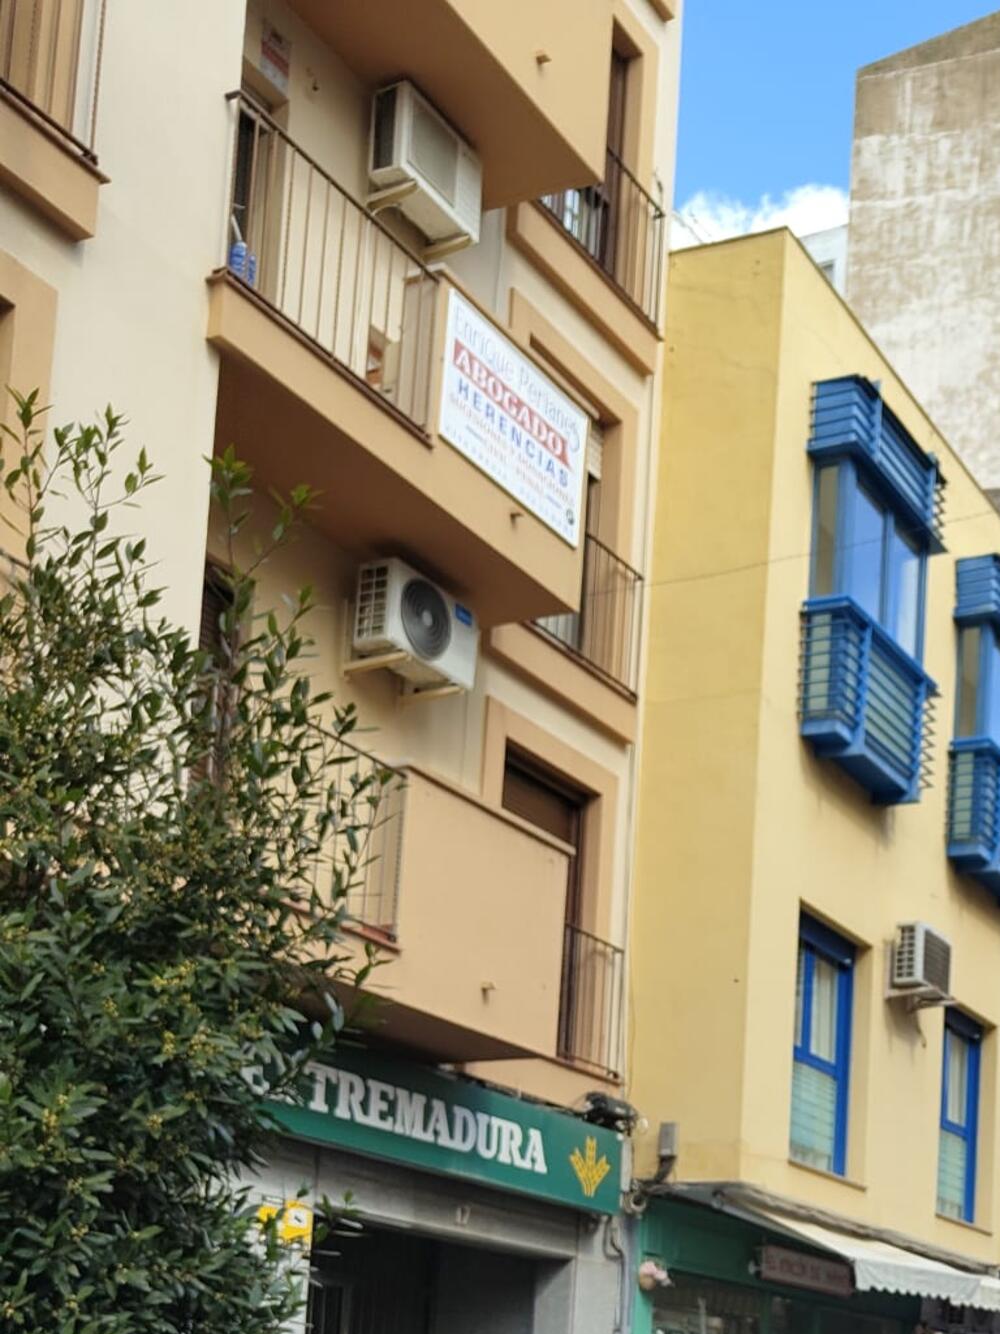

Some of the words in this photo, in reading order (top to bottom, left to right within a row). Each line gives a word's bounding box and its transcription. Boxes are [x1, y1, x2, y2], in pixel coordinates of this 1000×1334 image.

[455, 346, 566, 457] ABOGADO
[457, 377, 569, 489] HERENCIAS
[240, 1060, 547, 1174] TREMADURA
